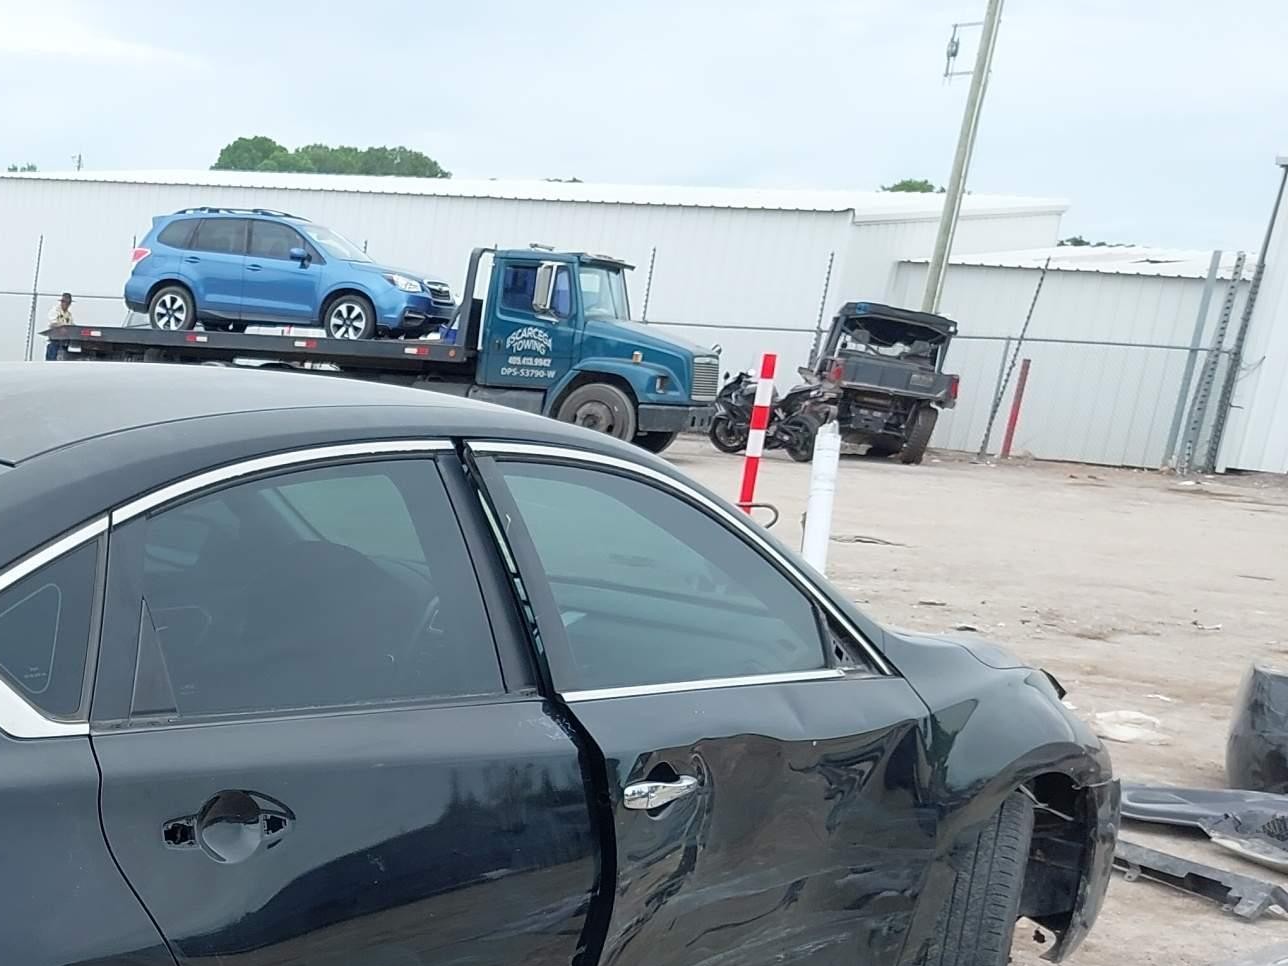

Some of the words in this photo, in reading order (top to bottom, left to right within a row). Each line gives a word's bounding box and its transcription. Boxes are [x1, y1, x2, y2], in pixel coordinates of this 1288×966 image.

[506, 327, 552, 351] ESCARCEGA
[512, 339, 546, 355] TOWING
[501, 367, 556, 378] DPS-53790-W
